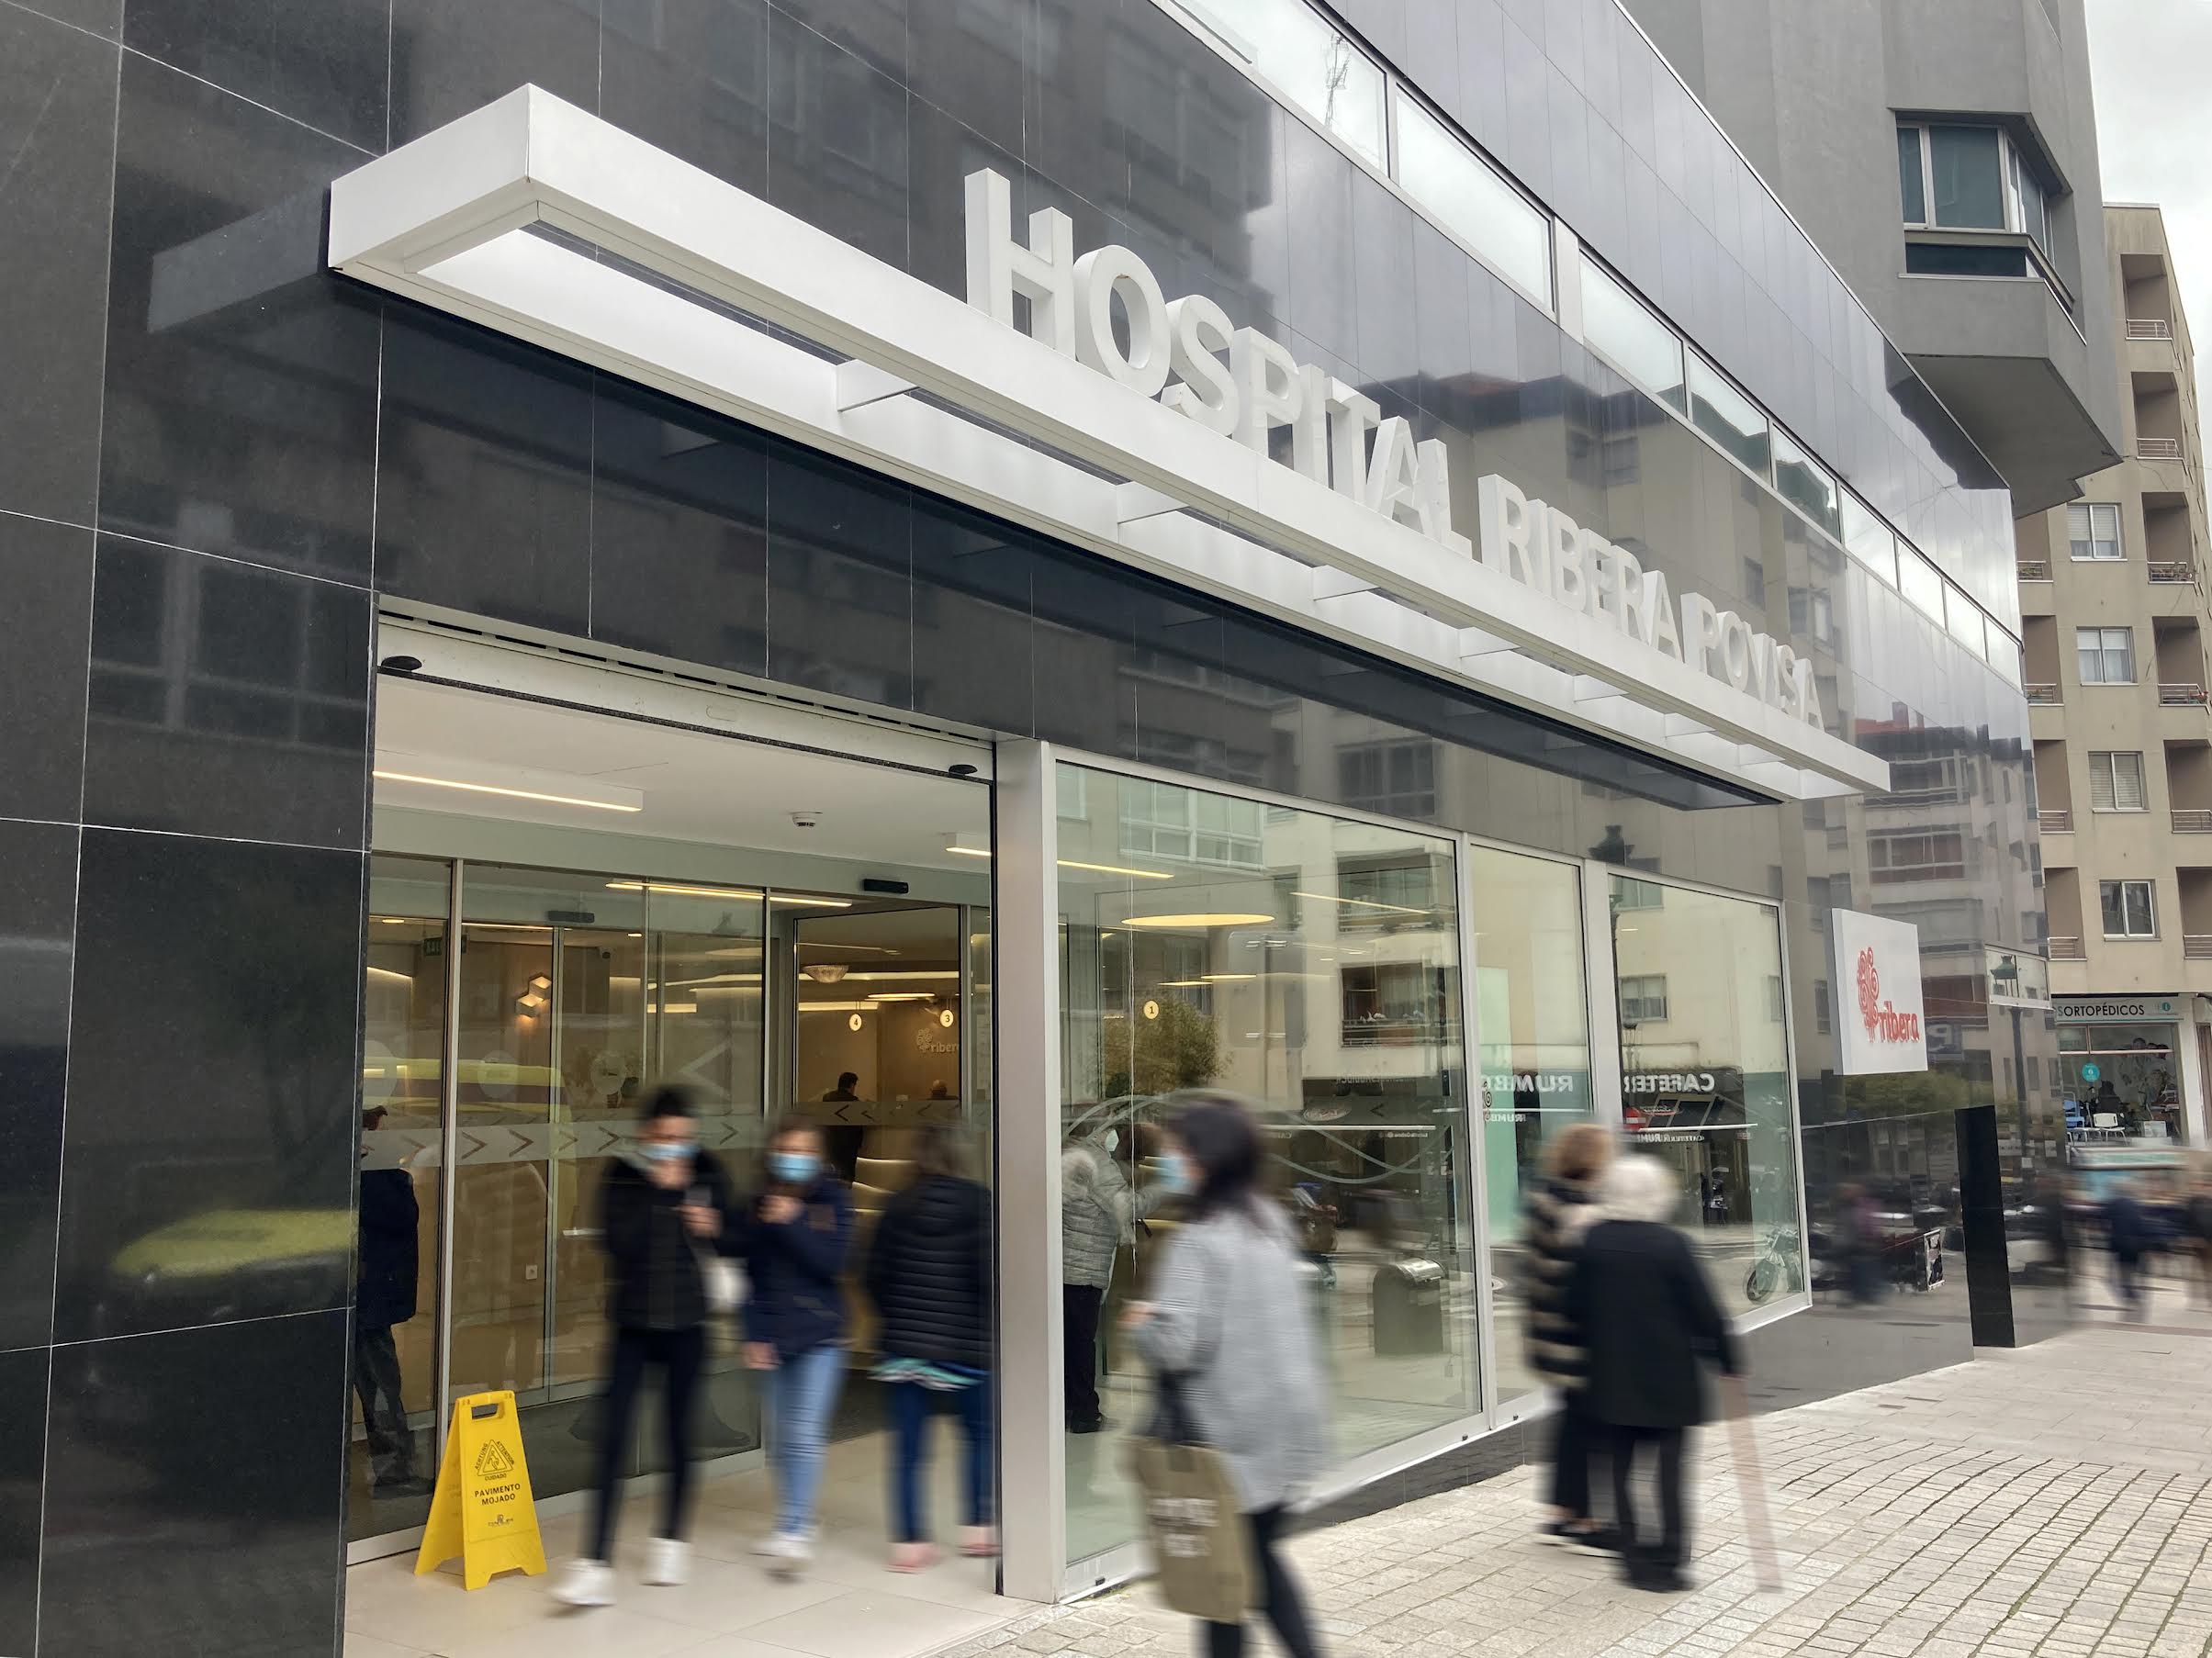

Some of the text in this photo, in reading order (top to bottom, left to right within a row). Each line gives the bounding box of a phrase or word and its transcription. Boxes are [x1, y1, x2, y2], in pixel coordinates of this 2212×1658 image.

[965, 168, 1825, 734] HOSPITAL RIBERA POVISA
[2063, 1003, 2145, 1017] ORTOPÉDICOS
[1878, 1001, 1920, 1042] ribera
[475, 1442, 488, 1470] ACHTUNG
[484, 1473, 507, 1482] CUIDADO
[474, 1483, 522, 1498] PAVIMENTO
[481, 1493, 516, 1506] MOJADO
